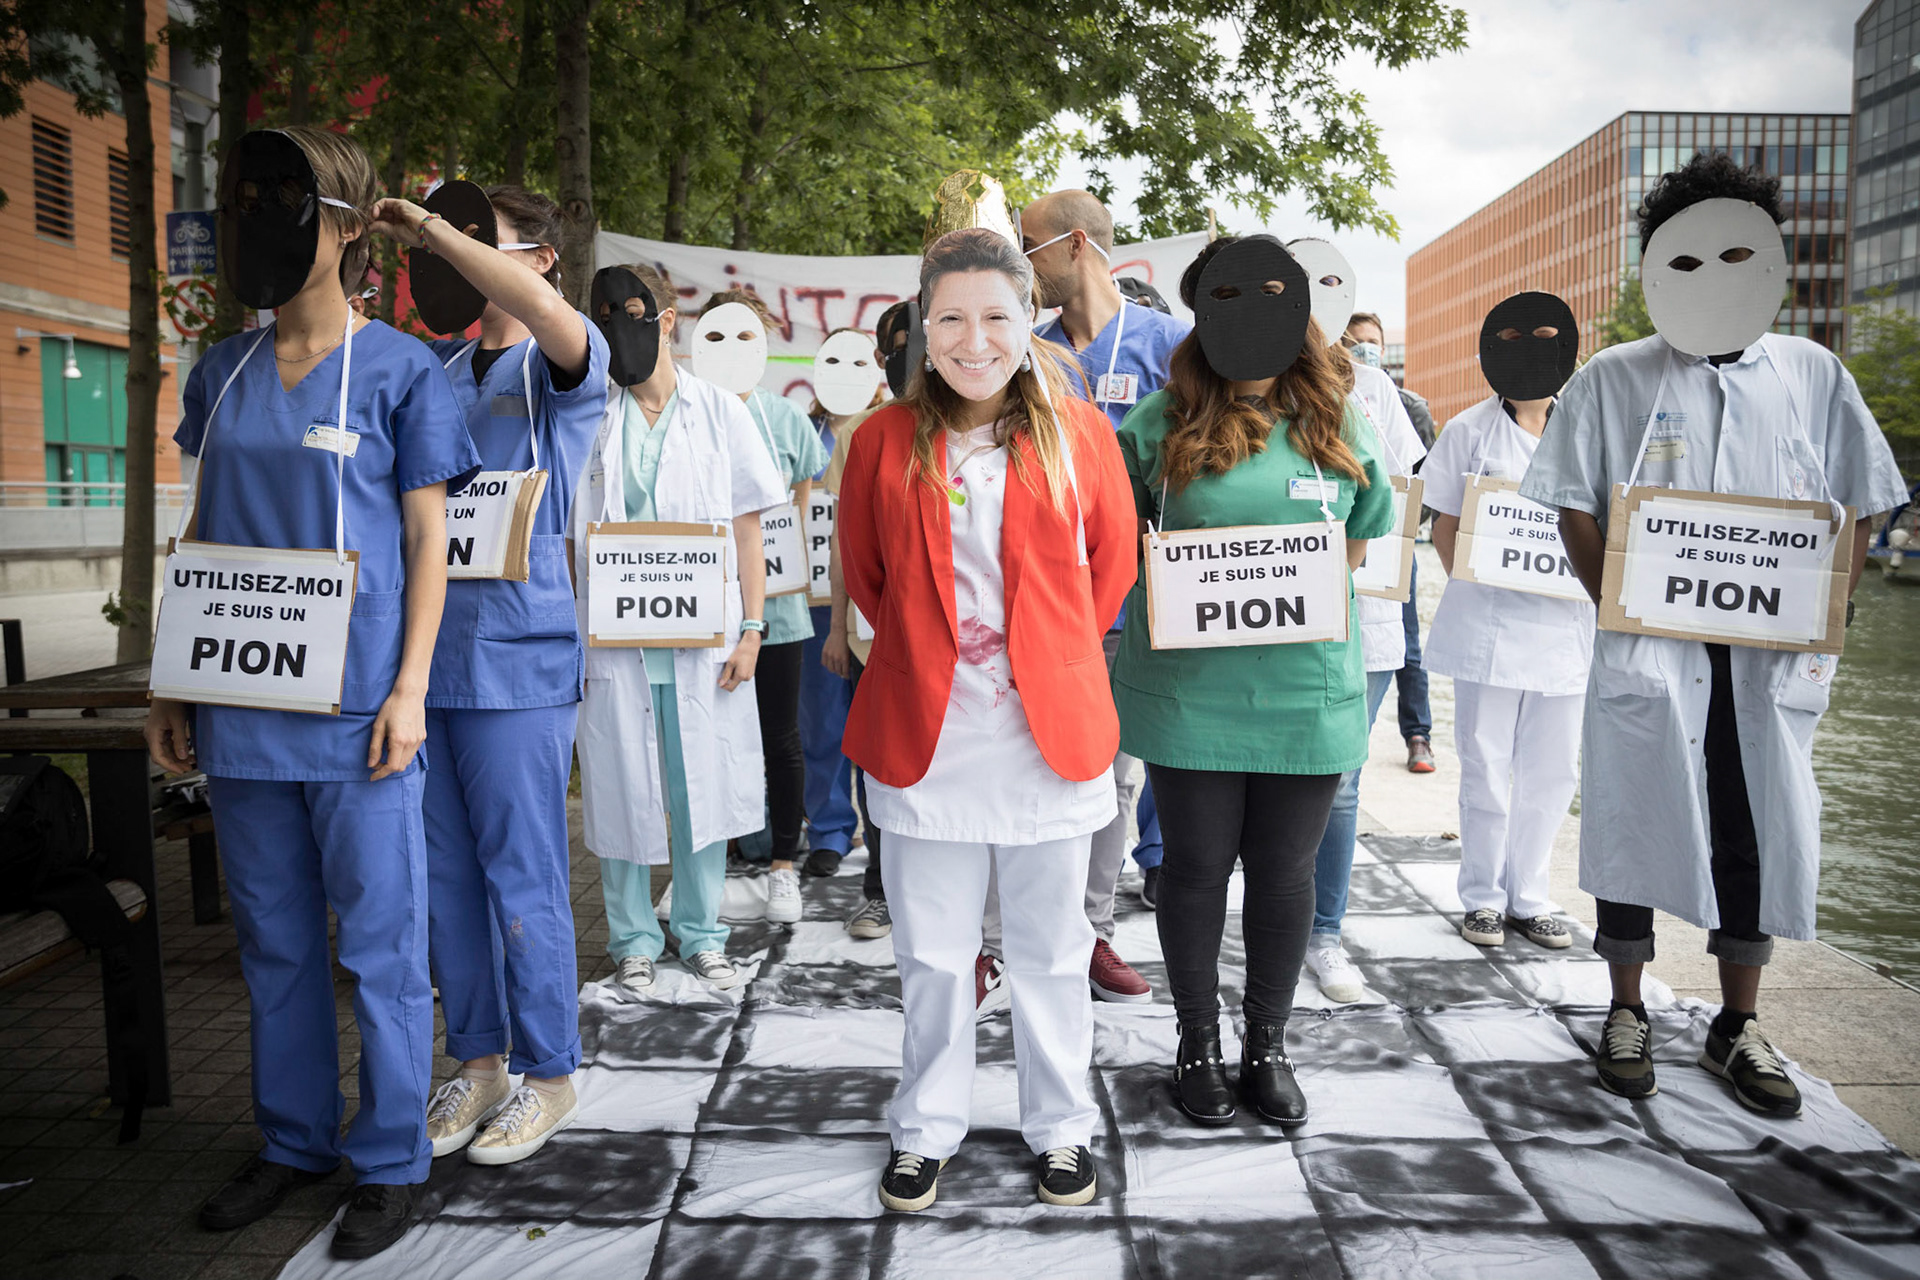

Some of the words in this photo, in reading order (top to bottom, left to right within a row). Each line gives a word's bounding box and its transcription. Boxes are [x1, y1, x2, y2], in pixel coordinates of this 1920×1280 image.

[171, 245, 216, 256] PARKING
[454, 508, 475, 519] UN
[1509, 527, 1525, 537] JE
[1528, 529, 1557, 541] SUIS
[1645, 518, 1818, 550] UTILISEZ-MOI
[595, 552, 717, 565] UTILISEZ-MOI
[1165, 535, 1329, 562] UTILISEZ-MOI
[1675, 547, 1698, 560] JE
[1703, 550, 1746, 565] SUIS
[1752, 555, 1779, 569] UN
[174, 569, 343, 598] UTILISEZ-MOI
[620, 573, 636, 582] JE
[640, 573, 671, 582] SUIS
[674, 573, 693, 582] UN
[1199, 571, 1220, 583] JE
[1225, 567, 1266, 581] SUIS
[1272, 565, 1297, 578] UN
[1665, 575, 1781, 616] PION
[203, 602, 225, 616] JE
[231, 604, 273, 619] SUIS
[279, 607, 306, 622] UN
[616, 596, 697, 618] PION
[1196, 596, 1306, 632] PION
[190, 637, 307, 678] PION
